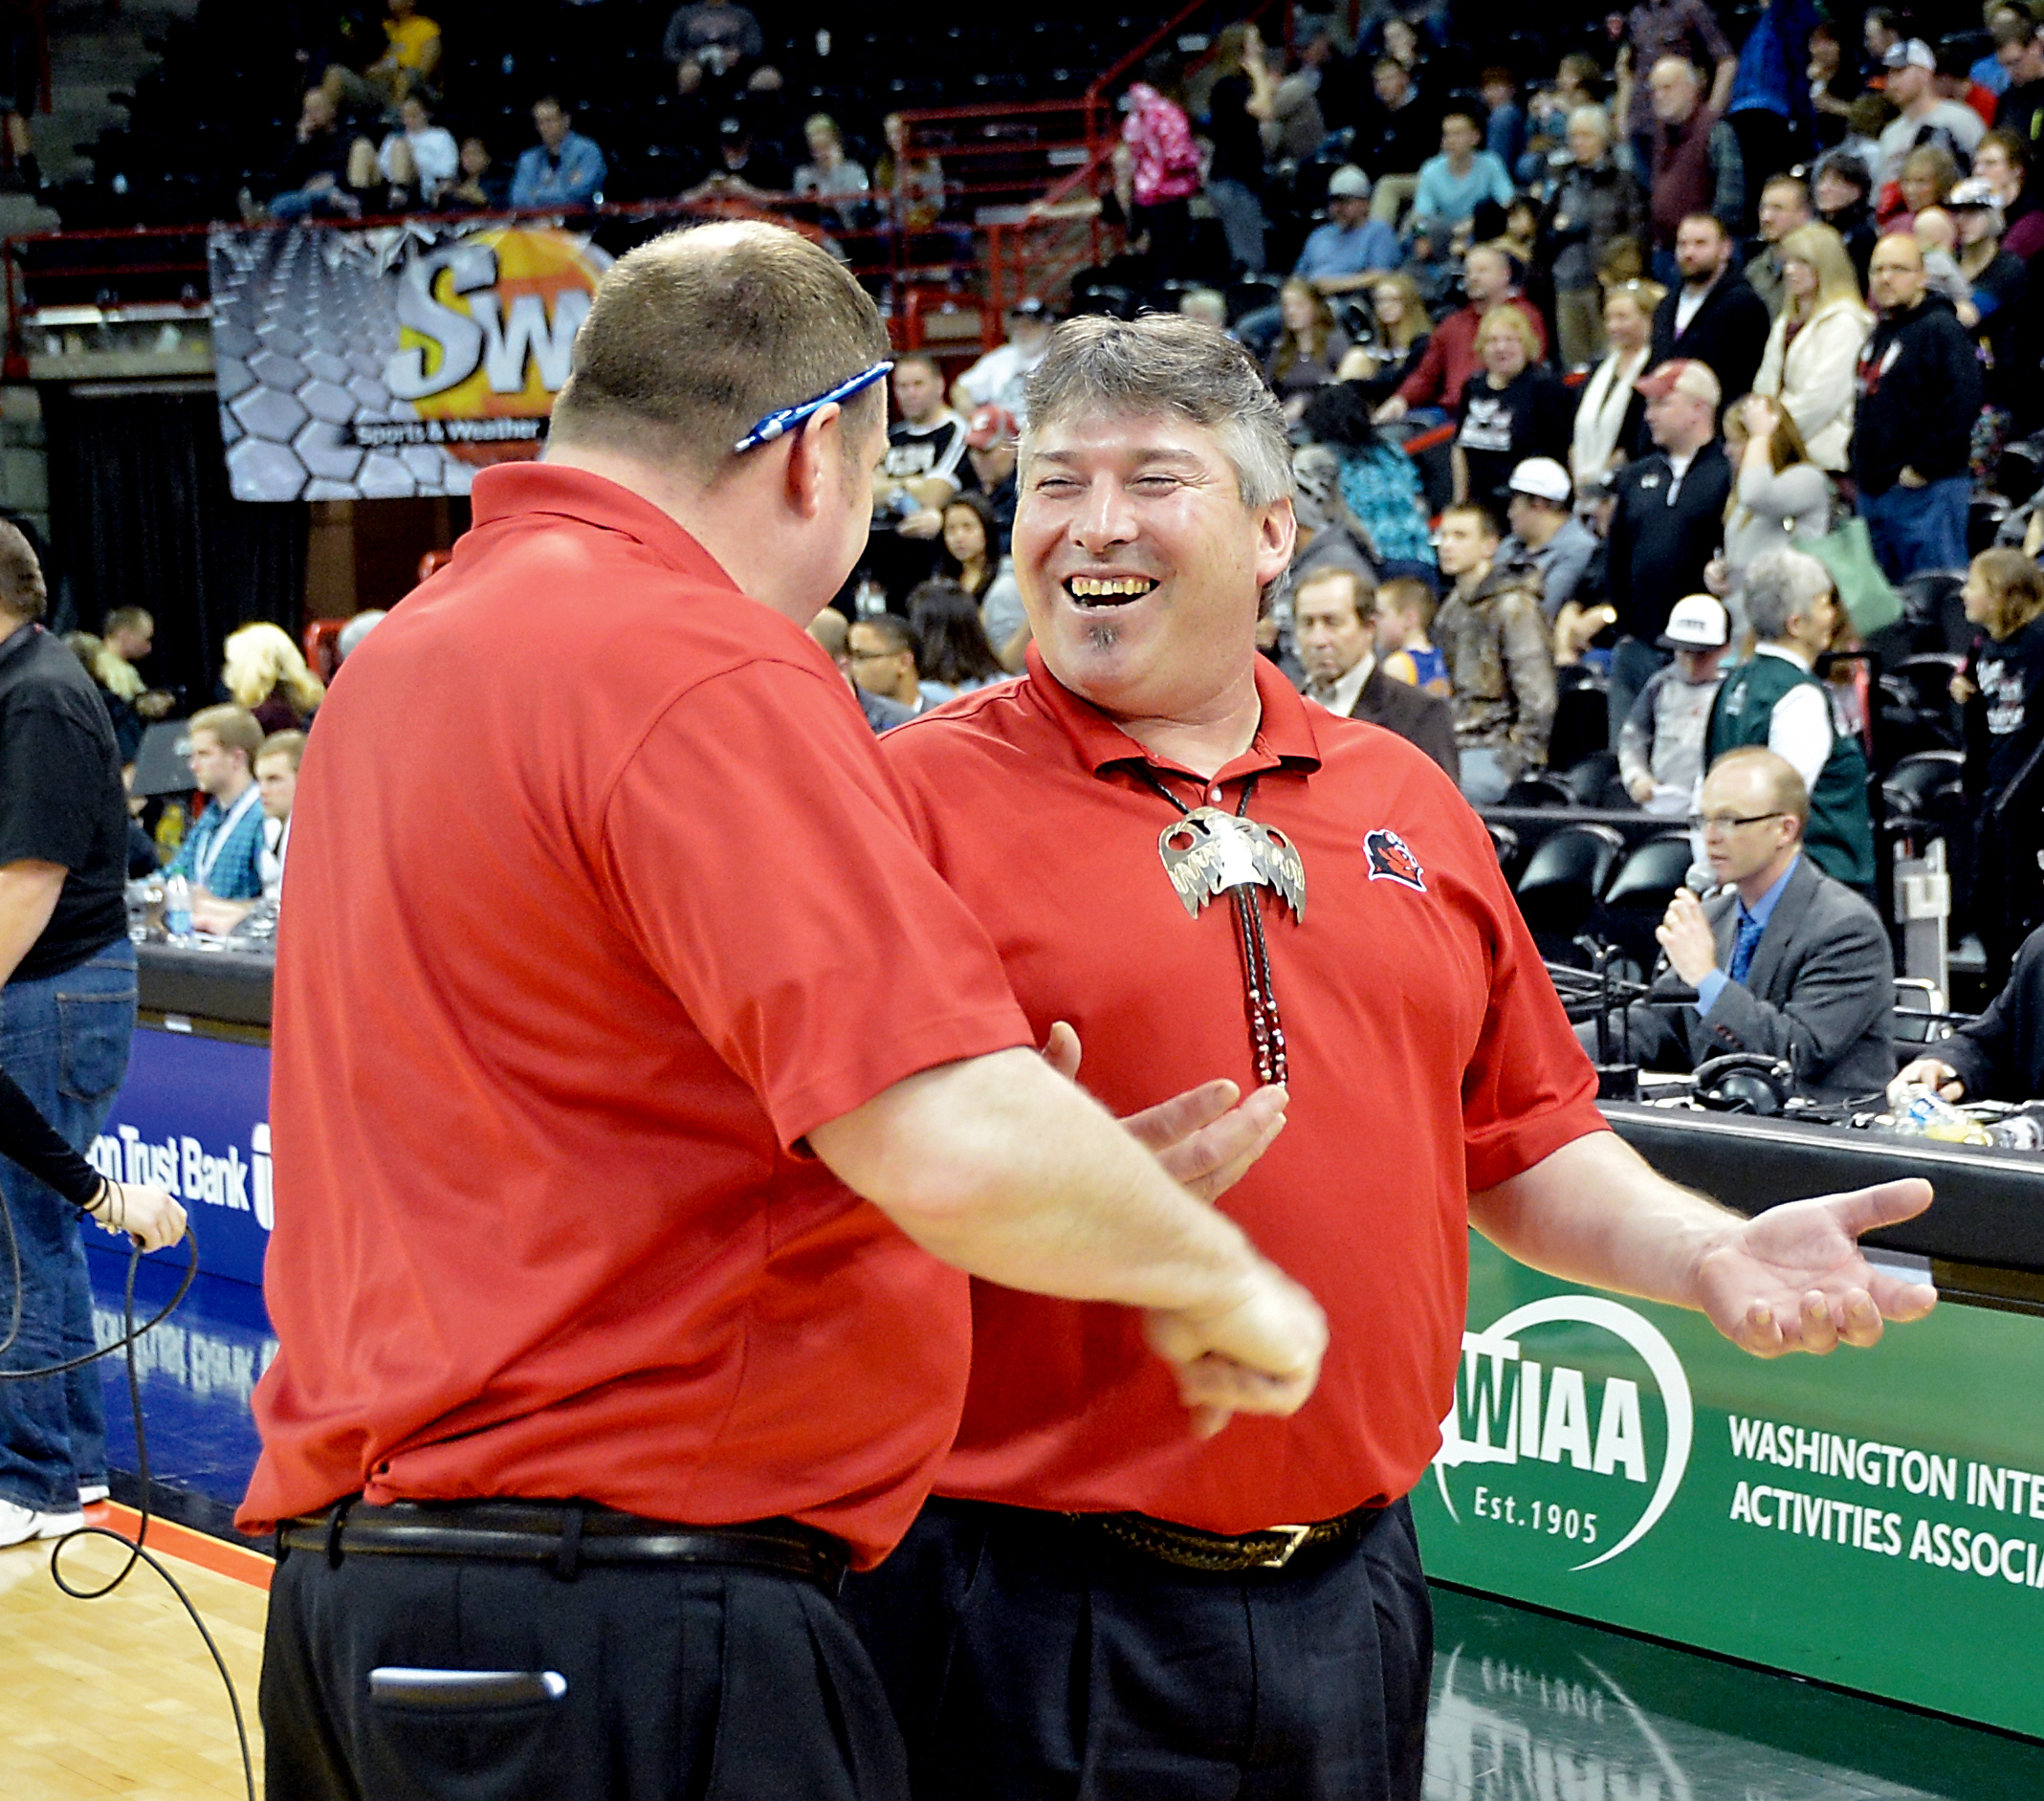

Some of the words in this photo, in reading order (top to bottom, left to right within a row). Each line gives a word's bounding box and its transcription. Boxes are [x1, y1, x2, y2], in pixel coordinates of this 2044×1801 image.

[356, 424, 427, 446] Sports
[428, 420, 445, 443] &
[446, 417, 540, 441] Weather
[84, 1133, 122, 1183] on
[118, 1123, 181, 1197] Trust
[181, 1134, 251, 1212] Bank
[1453, 1348, 1648, 1483] WIAA
[1728, 1415, 1958, 1502] WASHINGTON
[1967, 1461, 2044, 1521] INTE
[1474, 1486, 1597, 1544] Est.1905
[1729, 1481, 1901, 1556] ACTIVITIES
